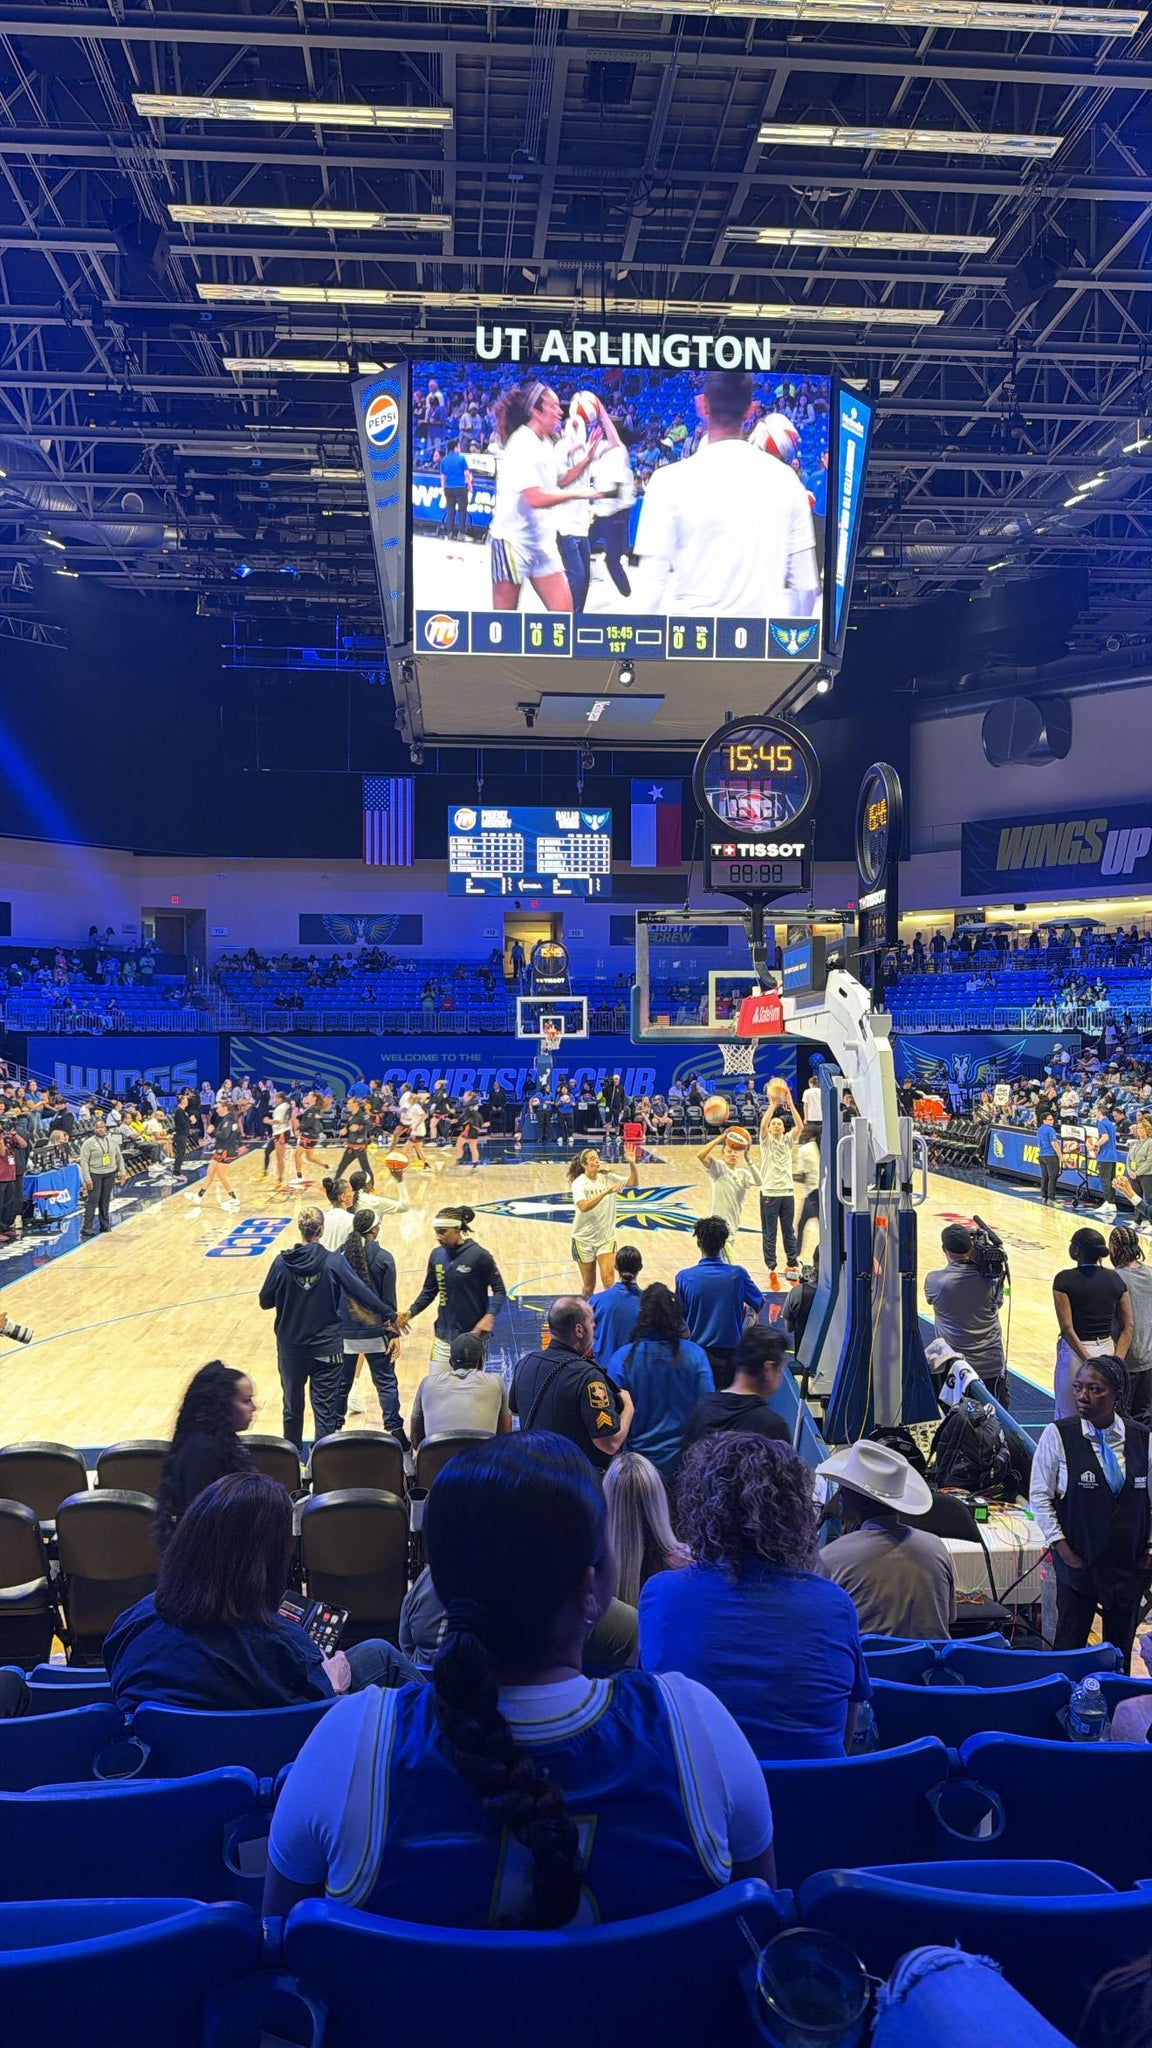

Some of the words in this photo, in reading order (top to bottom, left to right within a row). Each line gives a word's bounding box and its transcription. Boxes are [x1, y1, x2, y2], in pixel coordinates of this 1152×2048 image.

[475, 326, 527, 361] UT
[540, 329, 771, 371] ARLINGTON
[368, 412, 396, 430] PEPSI
[489, 621, 502, 643] 0
[531, 629, 543, 647] 0
[553, 630, 564, 647] 5
[606, 626, 633, 639] 15:45
[673, 632, 684, 649] 0
[696, 632, 707, 650] 5
[735, 627, 748, 649] 0
[609, 641, 627, 653] 1ST
[728, 745, 793, 772] 15:45
[736, 843, 805, 857] TISSOT
[995, 818, 1108, 871] WINGS
[1100, 827, 1152, 876] UP
[654, 932, 693, 943] CREW
[380, 1053, 439, 1062] WELCOME
[441, 1053, 457, 1062] TO
[458, 1053, 482, 1062] THE
[55, 1060, 197, 1096] WINGS
[382, 1068, 568, 1103] COURTSIE
[205, 1217, 293, 1258] GEICO
